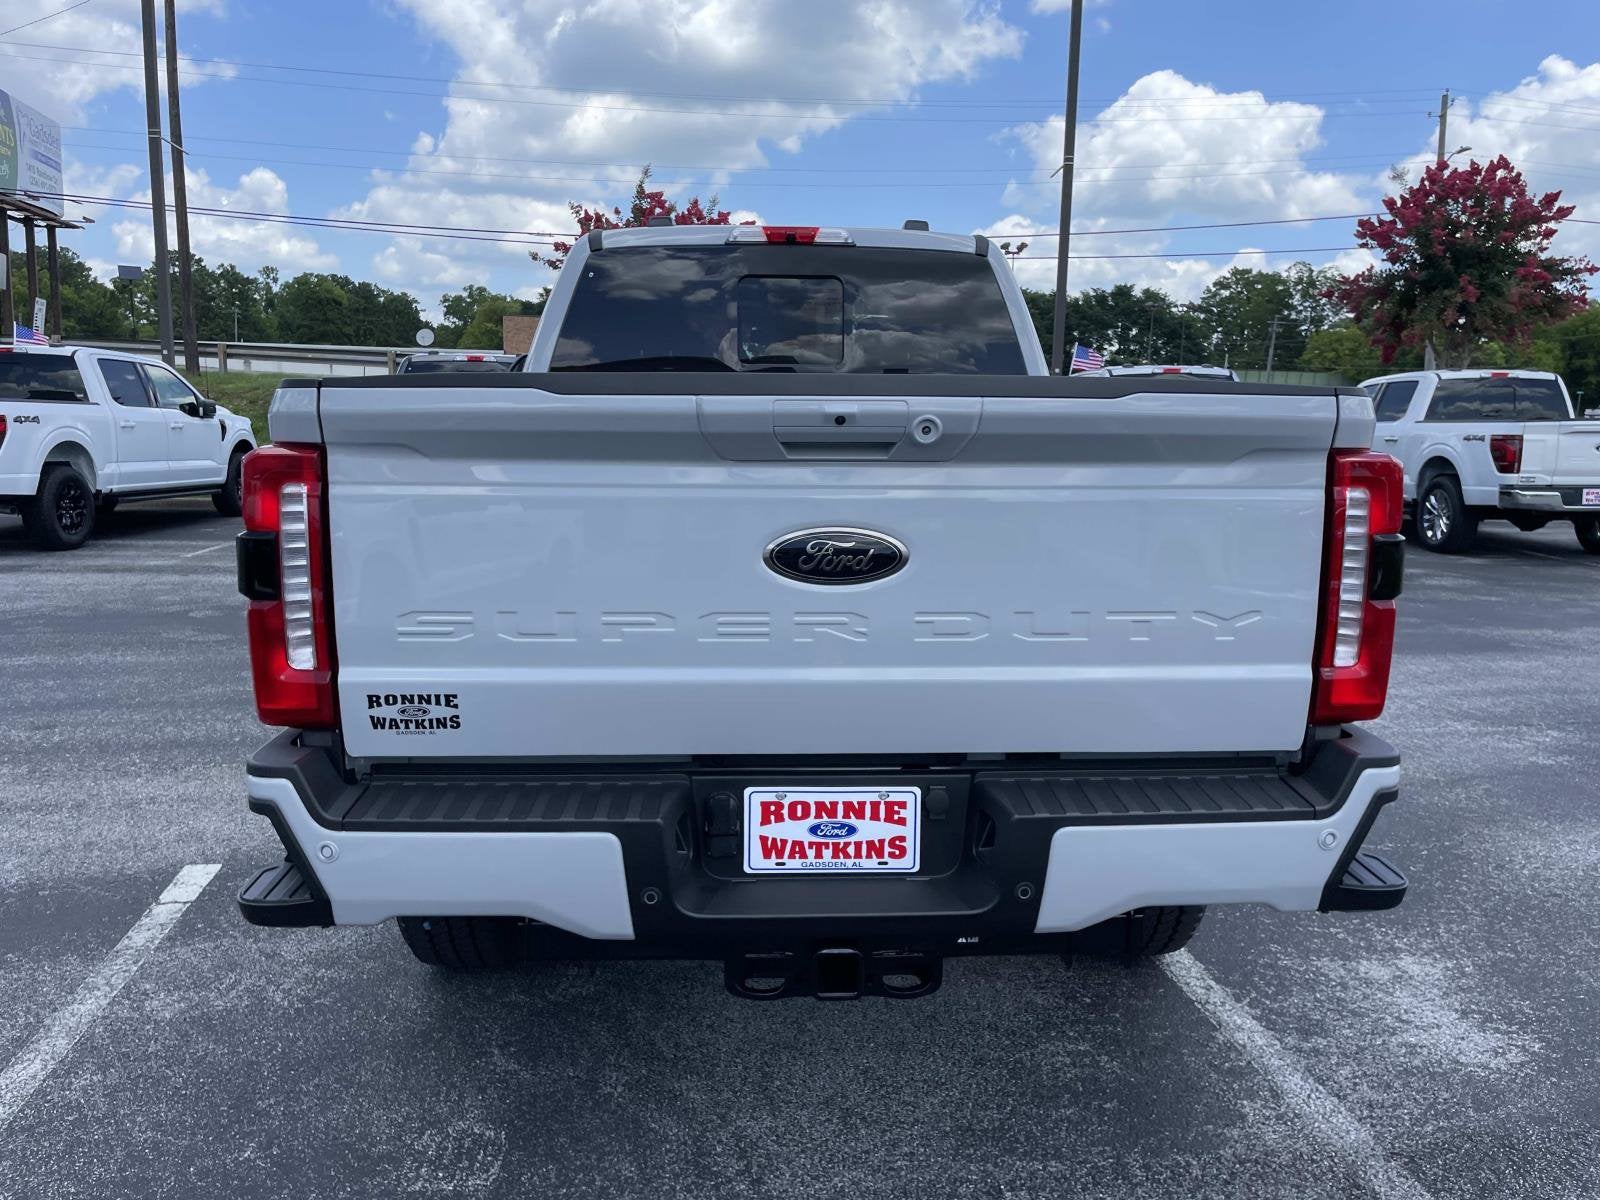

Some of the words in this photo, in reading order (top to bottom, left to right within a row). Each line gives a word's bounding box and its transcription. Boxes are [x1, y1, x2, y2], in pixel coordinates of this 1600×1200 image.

[798, 539, 875, 572] Ford
[397, 610, 868, 642] SUPER
[913, 610, 1262, 641] DUTY
[366, 693, 459, 709] RONNIE
[369, 714, 461, 730] WATKINS
[760, 800, 907, 827] RONNIE
[816, 823, 849, 837] Ford
[759, 834, 907, 860] WATKINS
[801, 861, 849, 869] GADSDEN,
